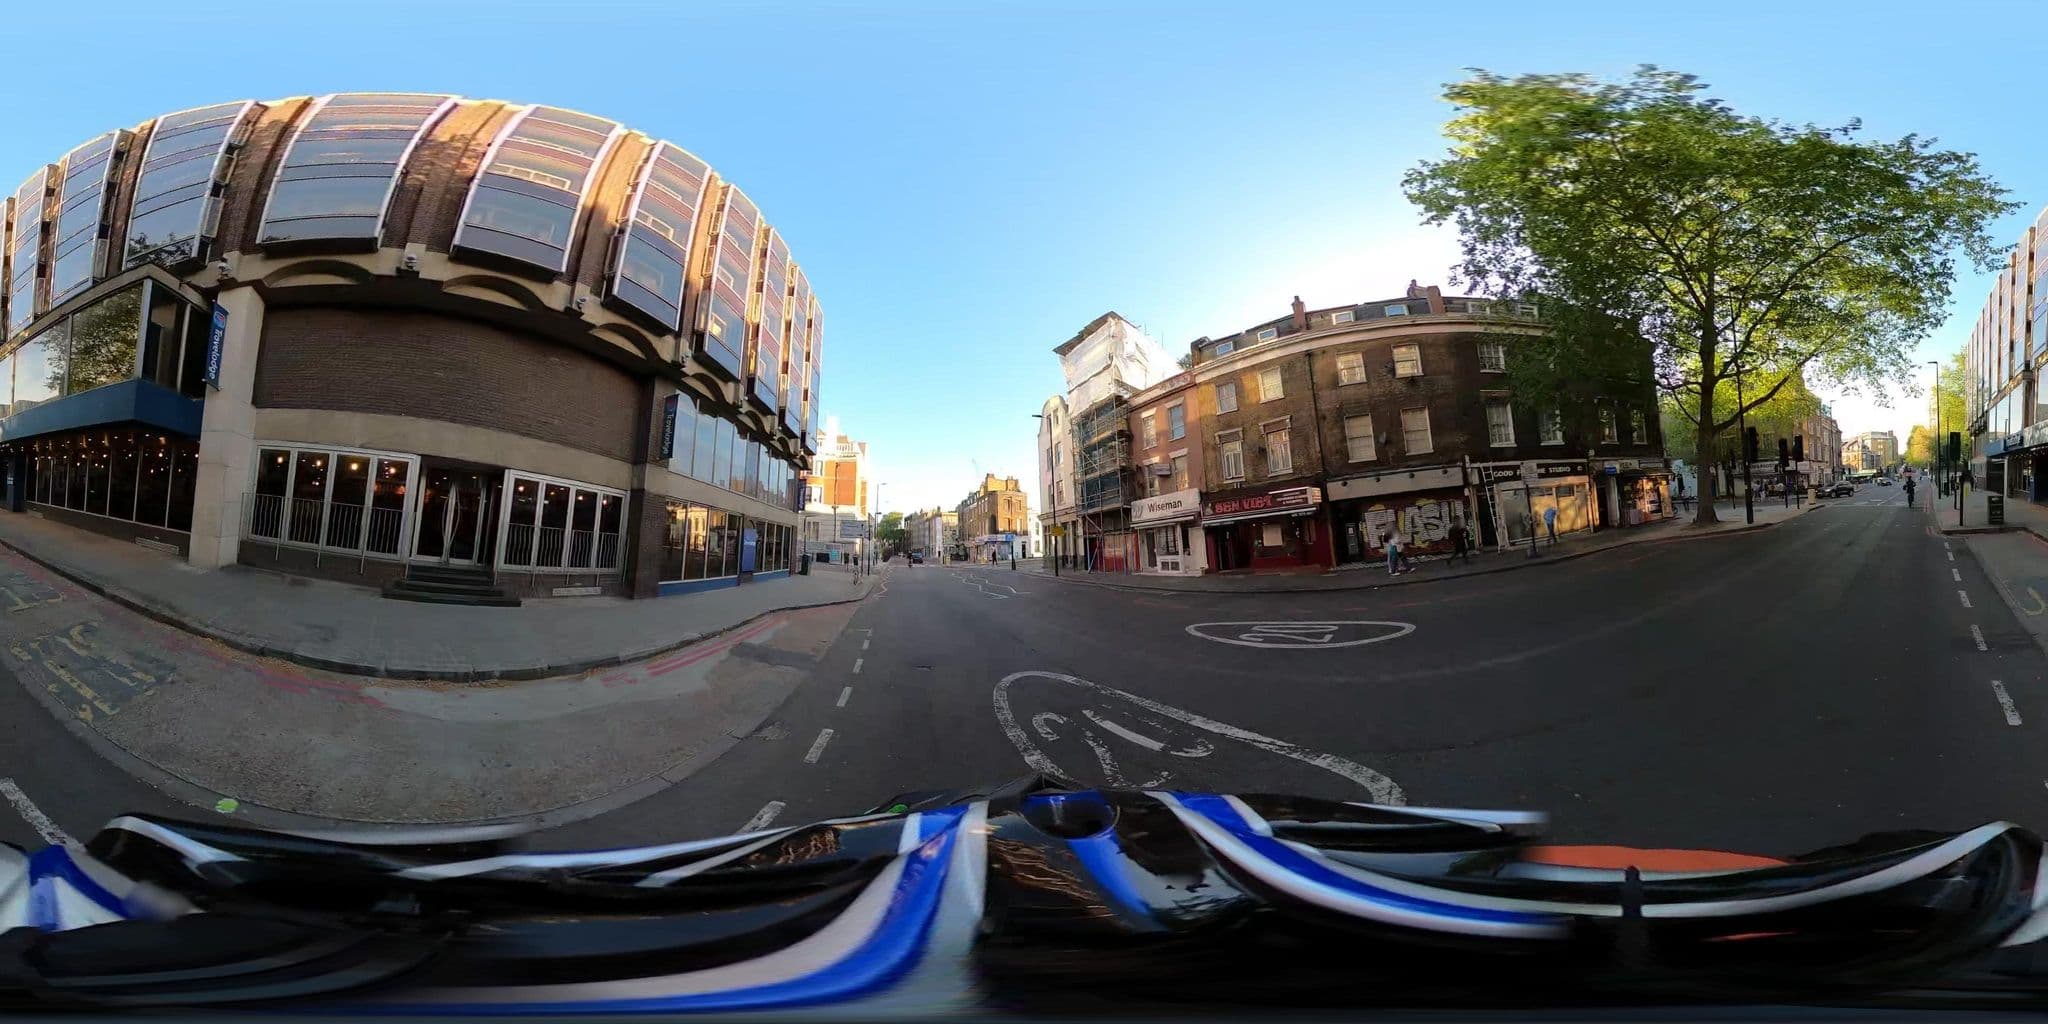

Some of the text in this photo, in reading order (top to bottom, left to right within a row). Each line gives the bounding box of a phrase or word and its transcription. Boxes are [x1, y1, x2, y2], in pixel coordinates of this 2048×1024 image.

[209, 329, 223, 379] Travelodge
[663, 414, 674, 455] Travelodge
[1493, 470, 1514, 478] GOOD
[1548, 466, 1572, 475] STUDIO
[1147, 500, 1183, 513] Wiseman
[1239, 625, 1339, 643] 20
